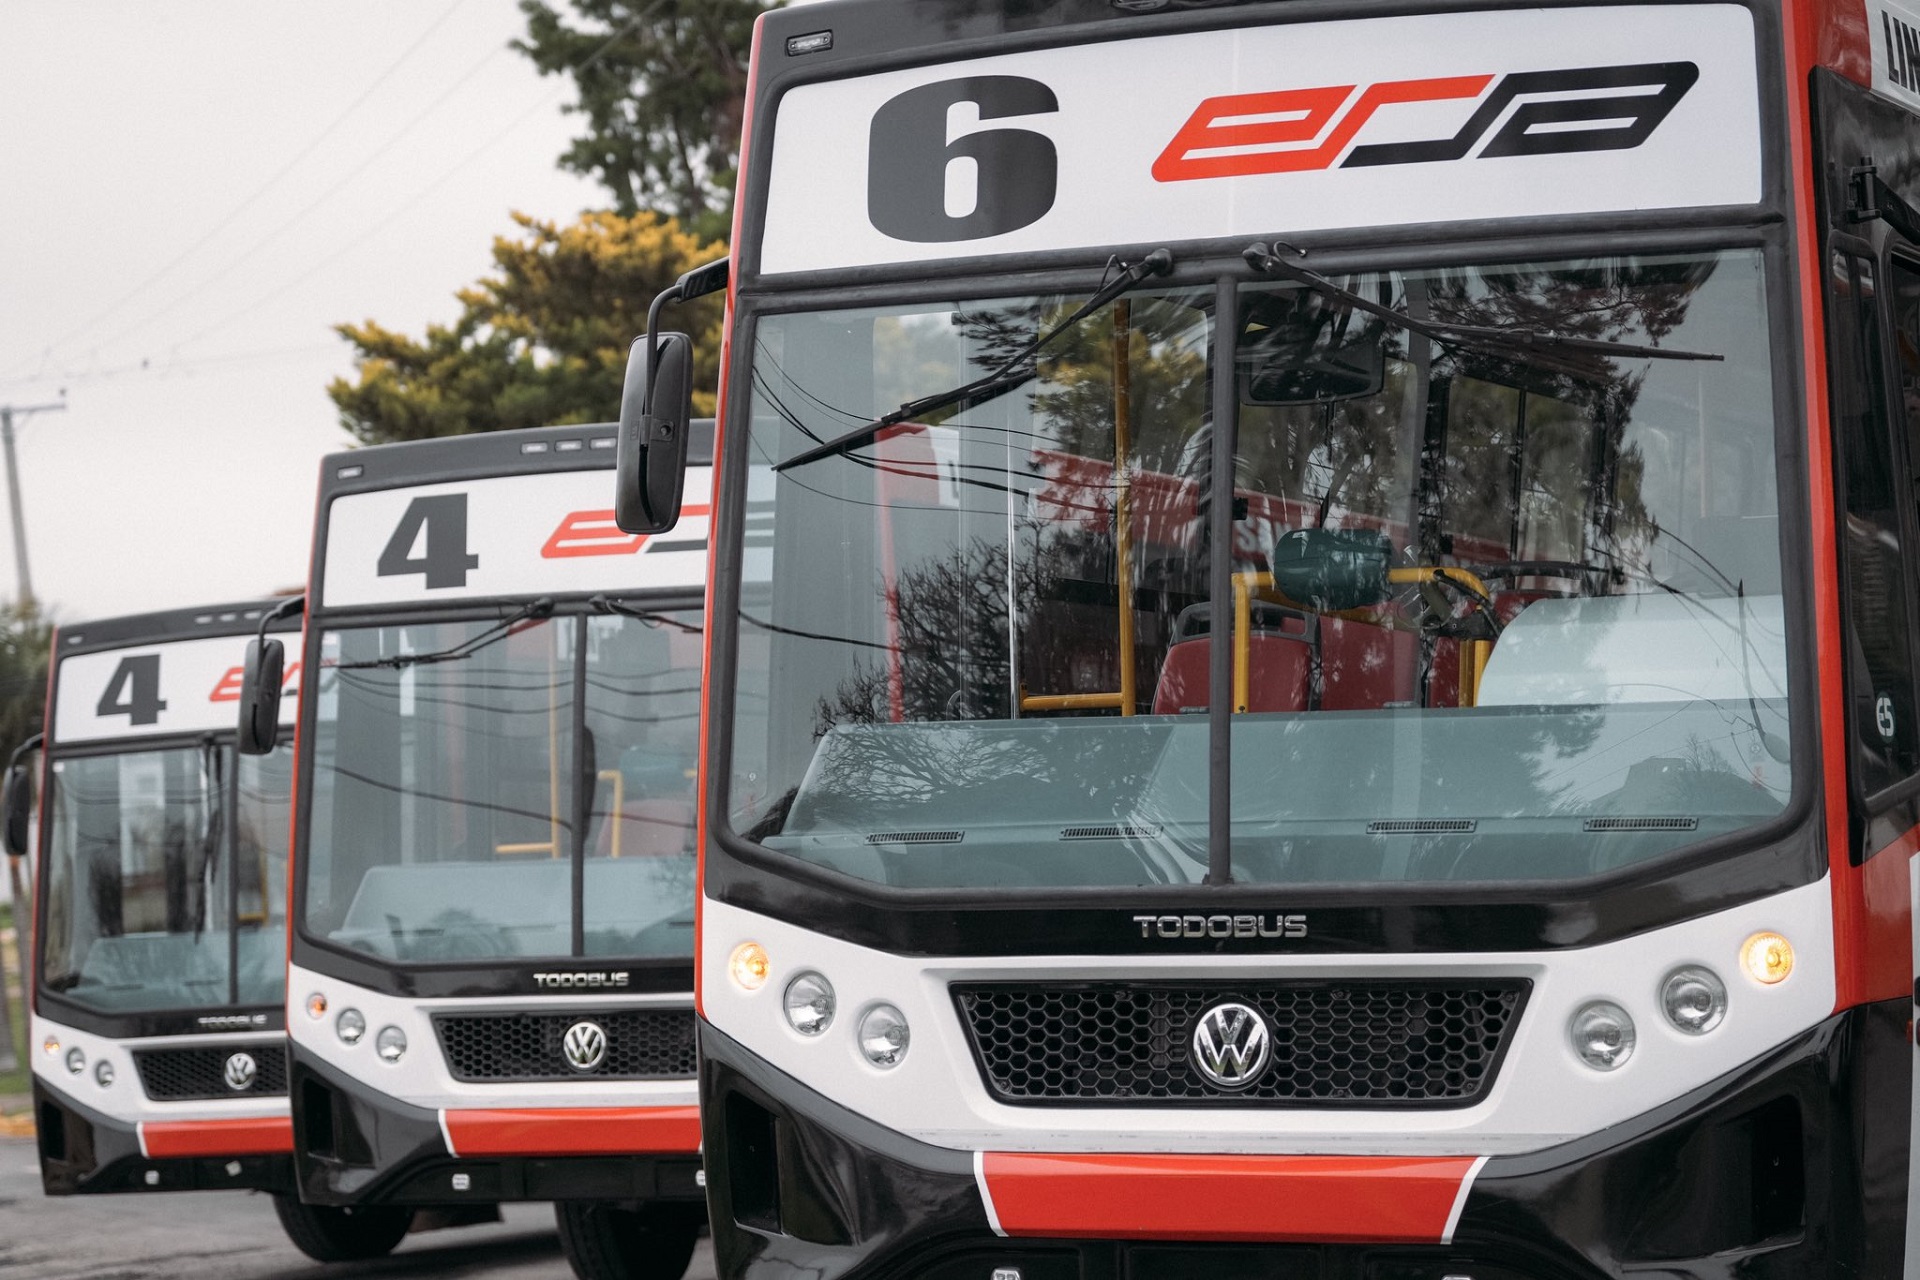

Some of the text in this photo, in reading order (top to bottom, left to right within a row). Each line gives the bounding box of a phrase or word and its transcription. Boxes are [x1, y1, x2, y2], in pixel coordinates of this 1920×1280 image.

[1881, 10, 1920, 95] LIN
[868, 75, 1059, 243] 6
[377, 493, 479, 590] 4
[96, 653, 167, 726] 4
[1133, 915, 1308, 938] TODOBUS
[533, 972, 630, 988] TODOBUS
